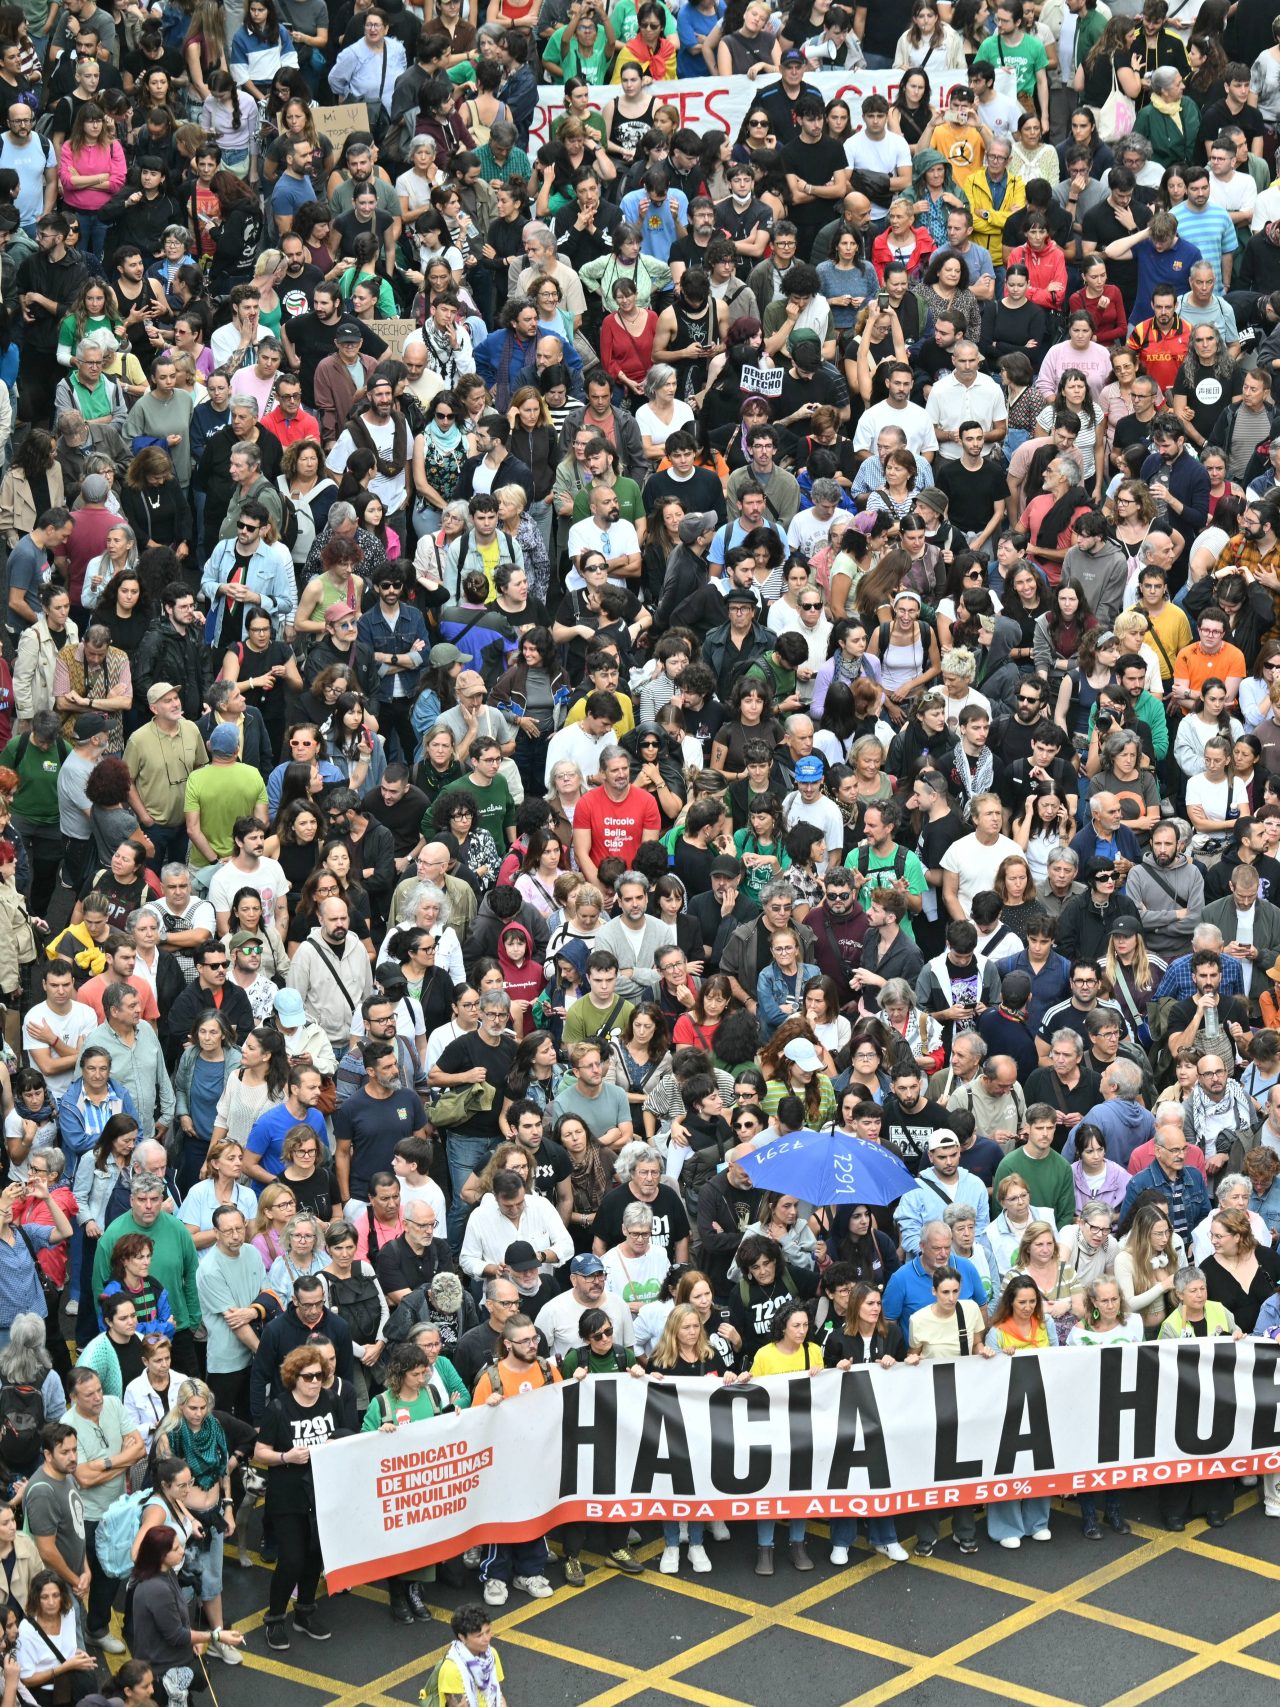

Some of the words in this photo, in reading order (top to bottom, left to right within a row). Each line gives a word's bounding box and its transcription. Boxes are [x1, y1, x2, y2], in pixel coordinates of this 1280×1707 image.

[1061, 361, 1100, 371] BERKELEY
[1146, 352, 1185, 362] ARAGN
[742, 374, 751, 384] A
[750, 377, 781, 390] TECHO
[744, 366, 783, 382] DERECHO
[604, 817, 635, 826] Circolo
[604, 829, 627, 837] Bella
[604, 839, 624, 847] Ciao
[753, 1139, 805, 1167] 7291
[832, 1152, 857, 1195] 7291
[290, 1412, 336, 1440] 7291
[558, 1369, 892, 1500] HACIA
[931, 1354, 1056, 1483] LA
[380, 1440, 469, 1474] SINDICATO
[381, 1476, 403, 1496] DE
[405, 1452, 491, 1490] INQUILINAS
[382, 1498, 392, 1514] E
[394, 1474, 481, 1512] INQUILINOS
[585, 1500, 716, 1518] BAJADA
[731, 1500, 791, 1517] DEL
[804, 1488, 961, 1517] ALQUILER
[974, 1480, 1033, 1501] 50%
[383, 1513, 405, 1532] DE
[406, 1496, 468, 1526] MADRID
